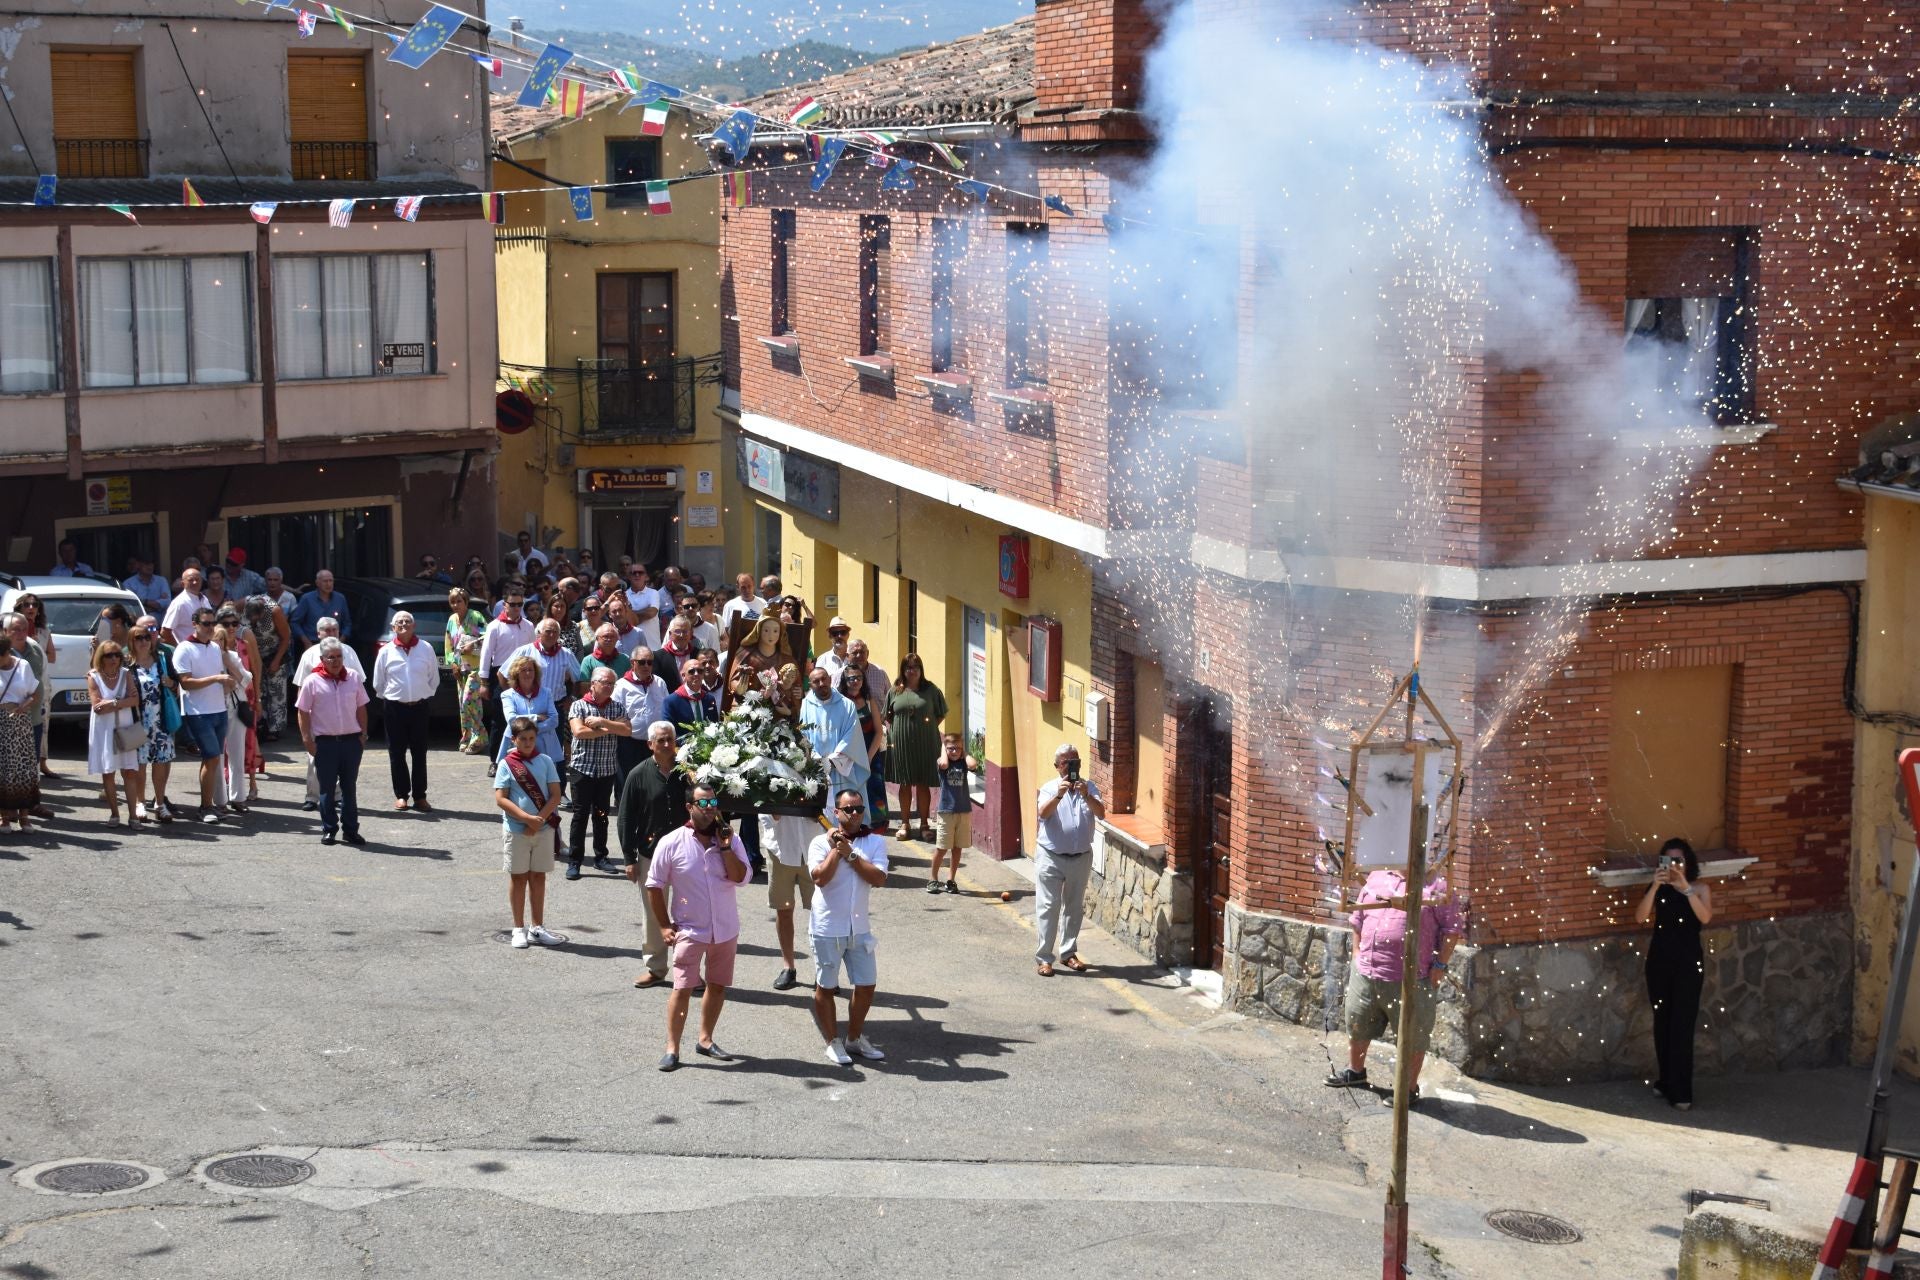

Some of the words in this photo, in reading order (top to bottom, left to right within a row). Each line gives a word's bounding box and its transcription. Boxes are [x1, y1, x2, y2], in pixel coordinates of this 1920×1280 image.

[384, 345, 394, 356] SE
[396, 345, 423, 356] VENDE
[613, 474, 667, 482] TABACOS
